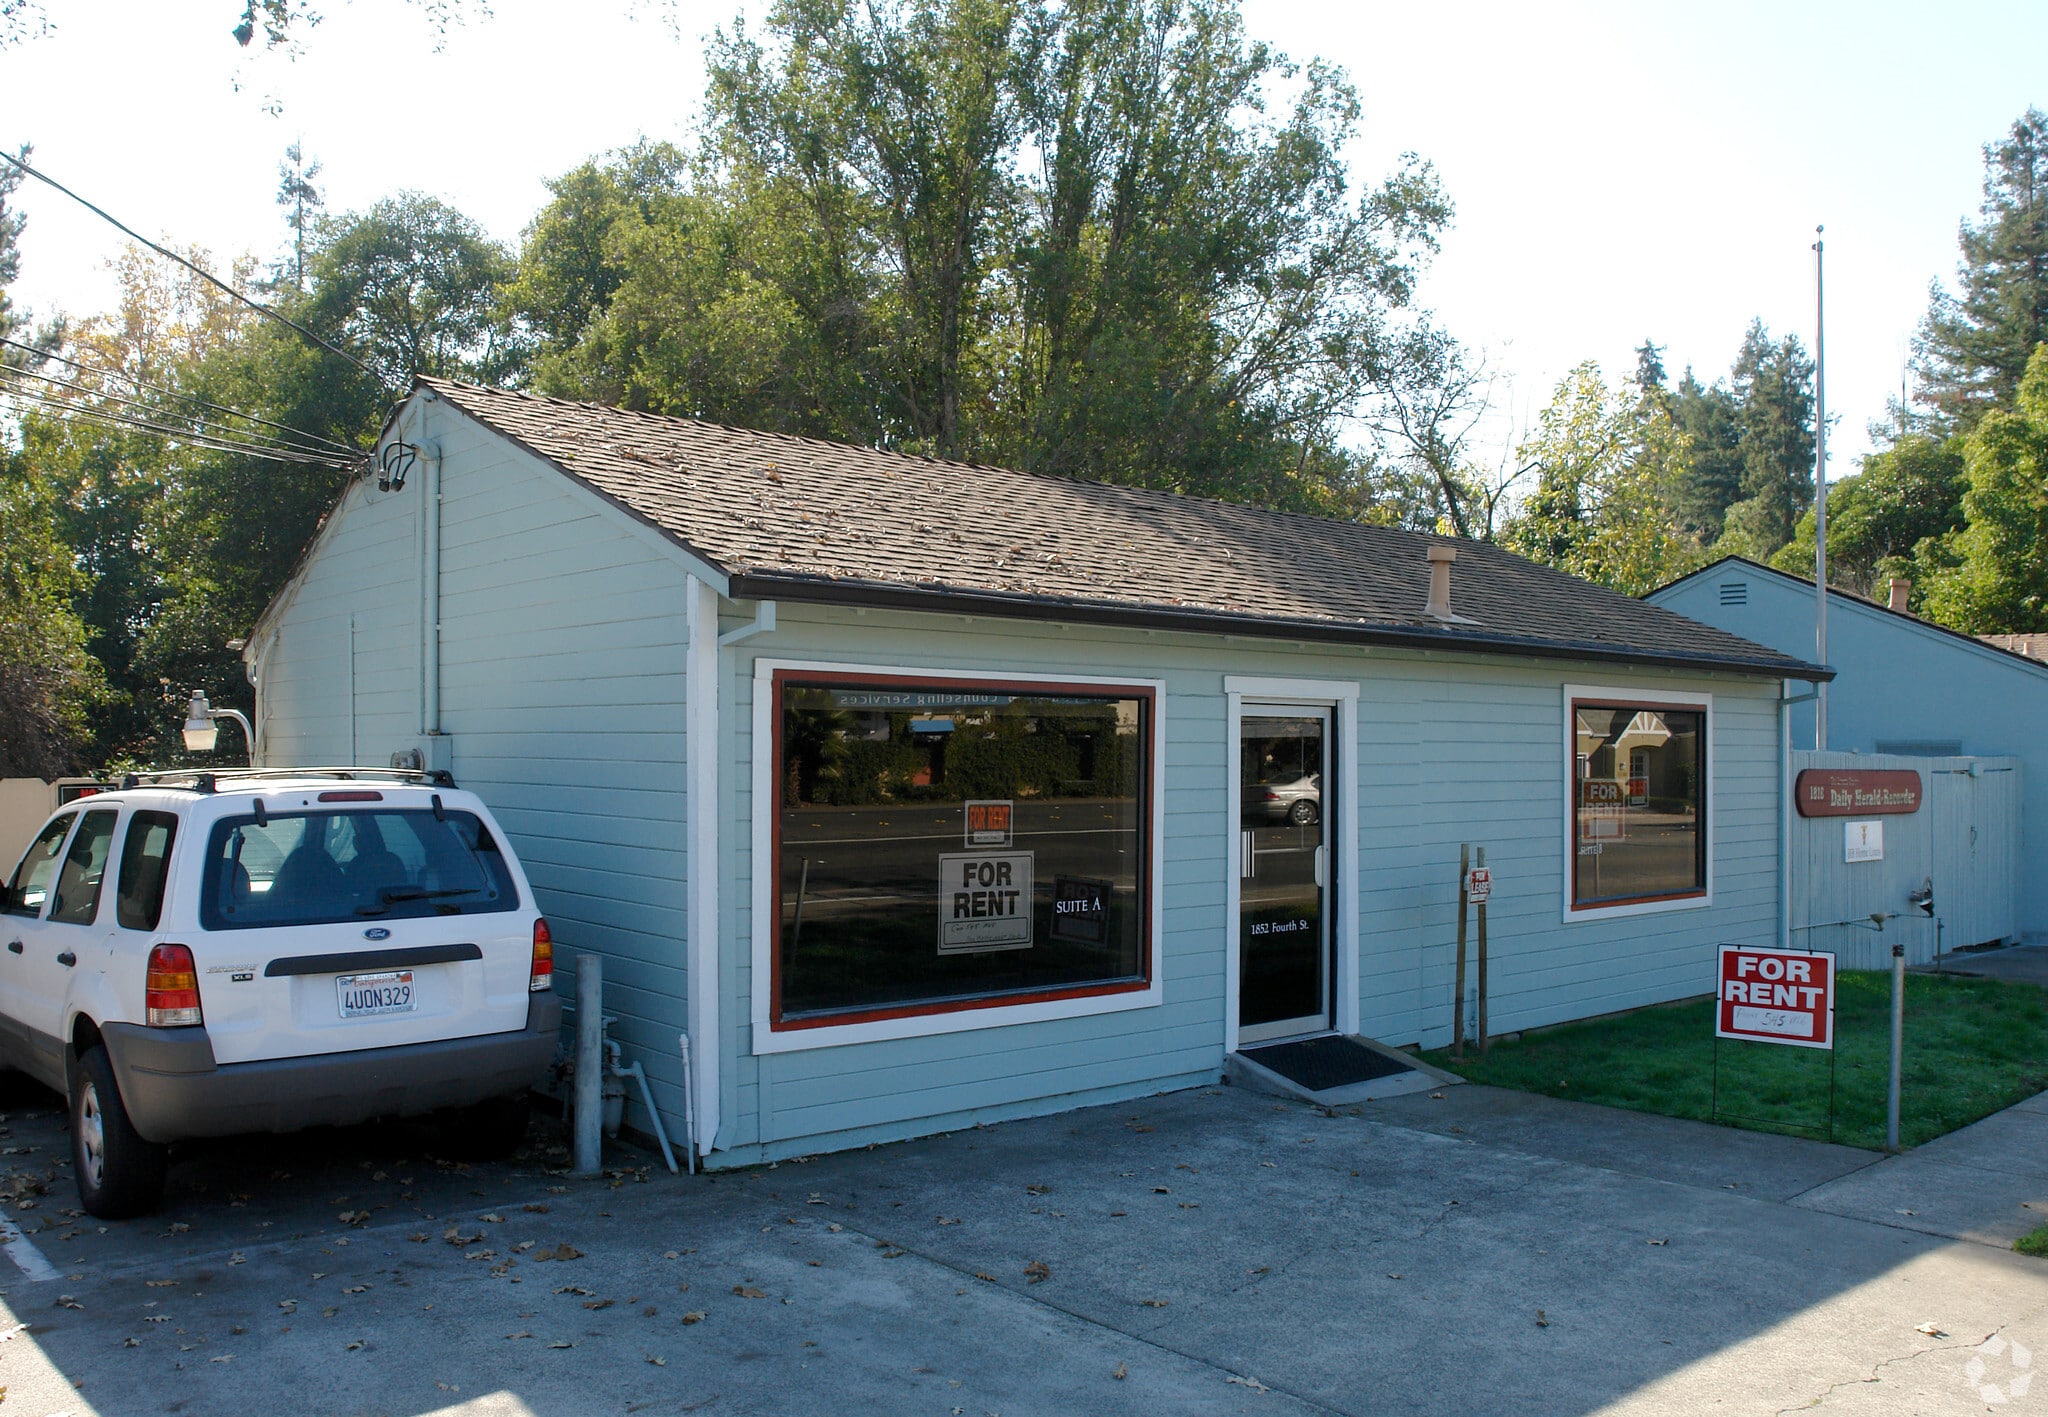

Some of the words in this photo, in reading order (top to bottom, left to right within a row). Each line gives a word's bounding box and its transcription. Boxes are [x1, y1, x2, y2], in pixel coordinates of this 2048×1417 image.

[1590, 785, 1617, 800] FOR
[1830, 788, 1853, 811] Daily
[969, 805, 986, 831] FOR
[987, 805, 1010, 830] RENT
[963, 861, 1012, 888] FOR
[1471, 881, 1489, 893] LEASE
[953, 889, 1020, 919] RENT
[1056, 900, 1088, 914] SUITE
[1092, 897, 1101, 911] A
[369, 929, 387, 938] Ford
[1251, 923, 1270, 935] 1852
[1271, 920, 1297, 933] Fourth
[1299, 919, 1310, 930] St.
[1737, 955, 1811, 983] FOR
[345, 986, 410, 1010] 4UON329
[1725, 979, 1824, 1009] RENT
[1761, 1012, 1786, 1027] 545
